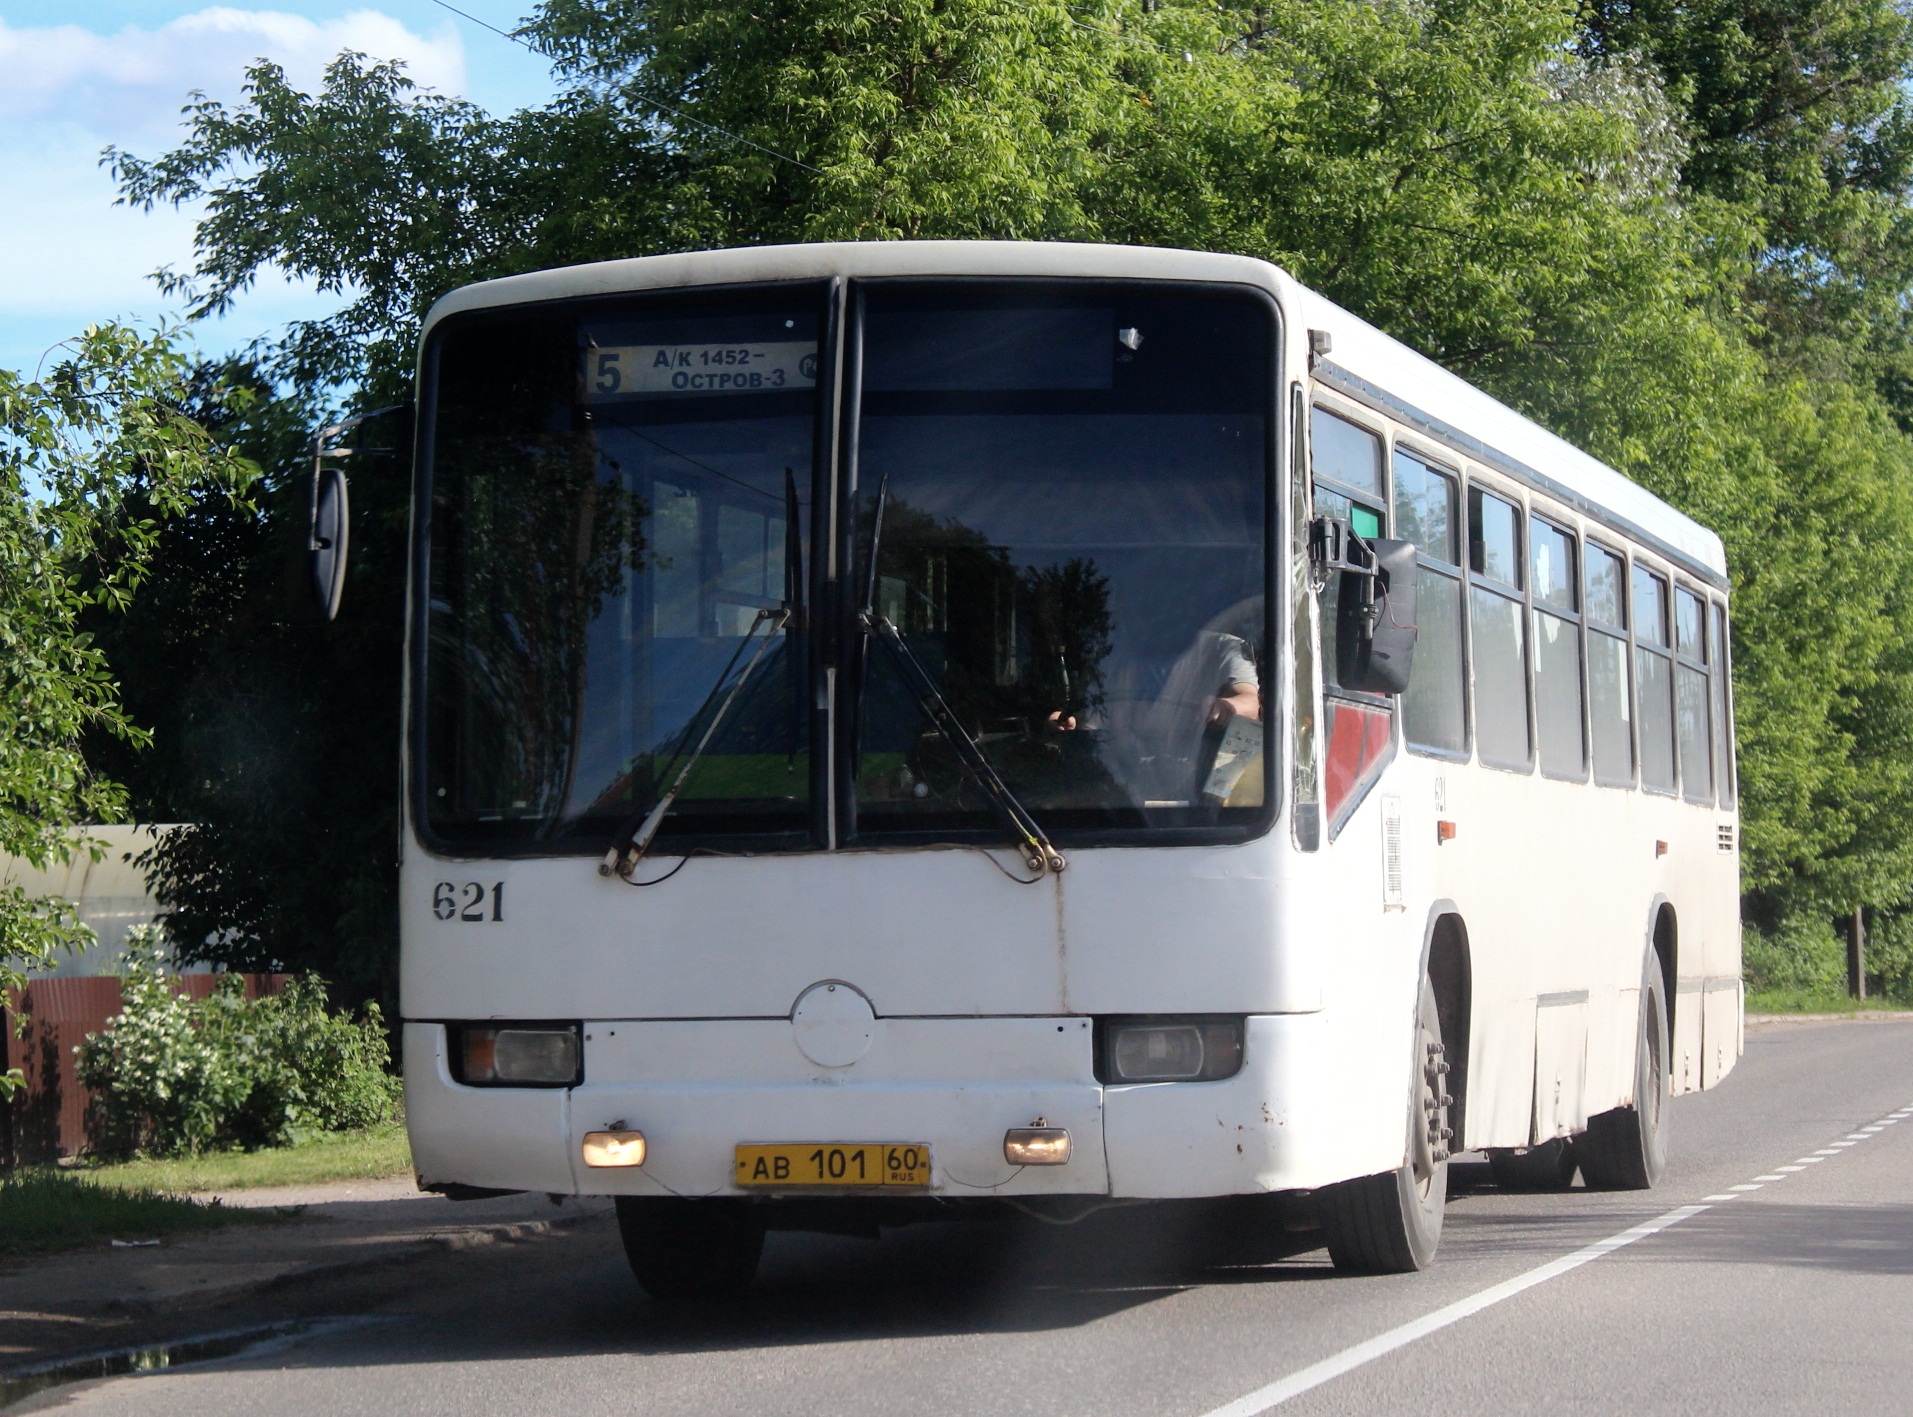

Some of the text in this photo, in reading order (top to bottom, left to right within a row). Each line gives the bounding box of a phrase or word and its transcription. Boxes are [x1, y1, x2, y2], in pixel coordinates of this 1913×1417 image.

[595, 353, 622, 394] 5
[653, 348, 692, 370] А/К
[1435, 776, 1446, 812] 621
[433, 881, 505, 922] 621
[752, 1148, 918, 1180] АВ 101 60
[891, 1172, 915, 1182] RUS
